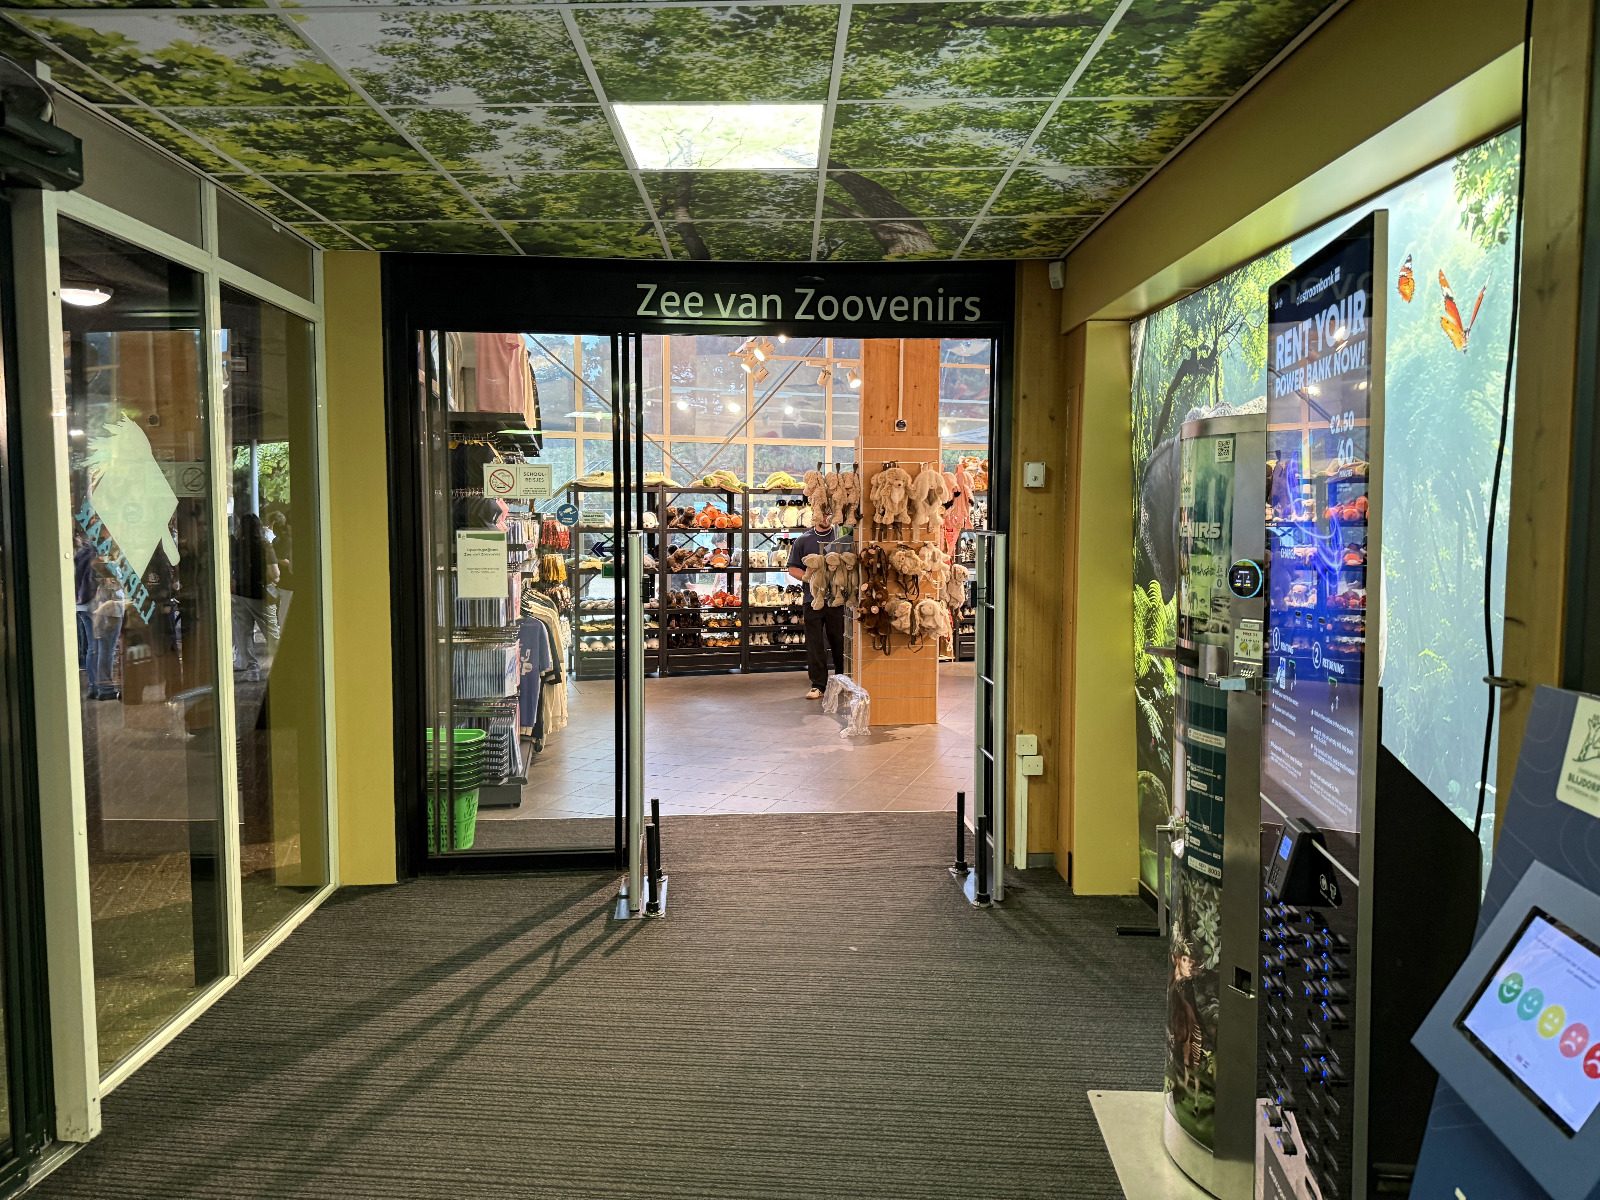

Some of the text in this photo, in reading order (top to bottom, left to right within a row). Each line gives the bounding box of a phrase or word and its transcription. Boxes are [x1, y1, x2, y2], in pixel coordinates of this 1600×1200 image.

[636, 283, 981, 322] Zee van Zoovenirs
[1275, 290, 1366, 371] RENT YOUR
[1275, 340, 1366, 399] POWER BANK NOW!
